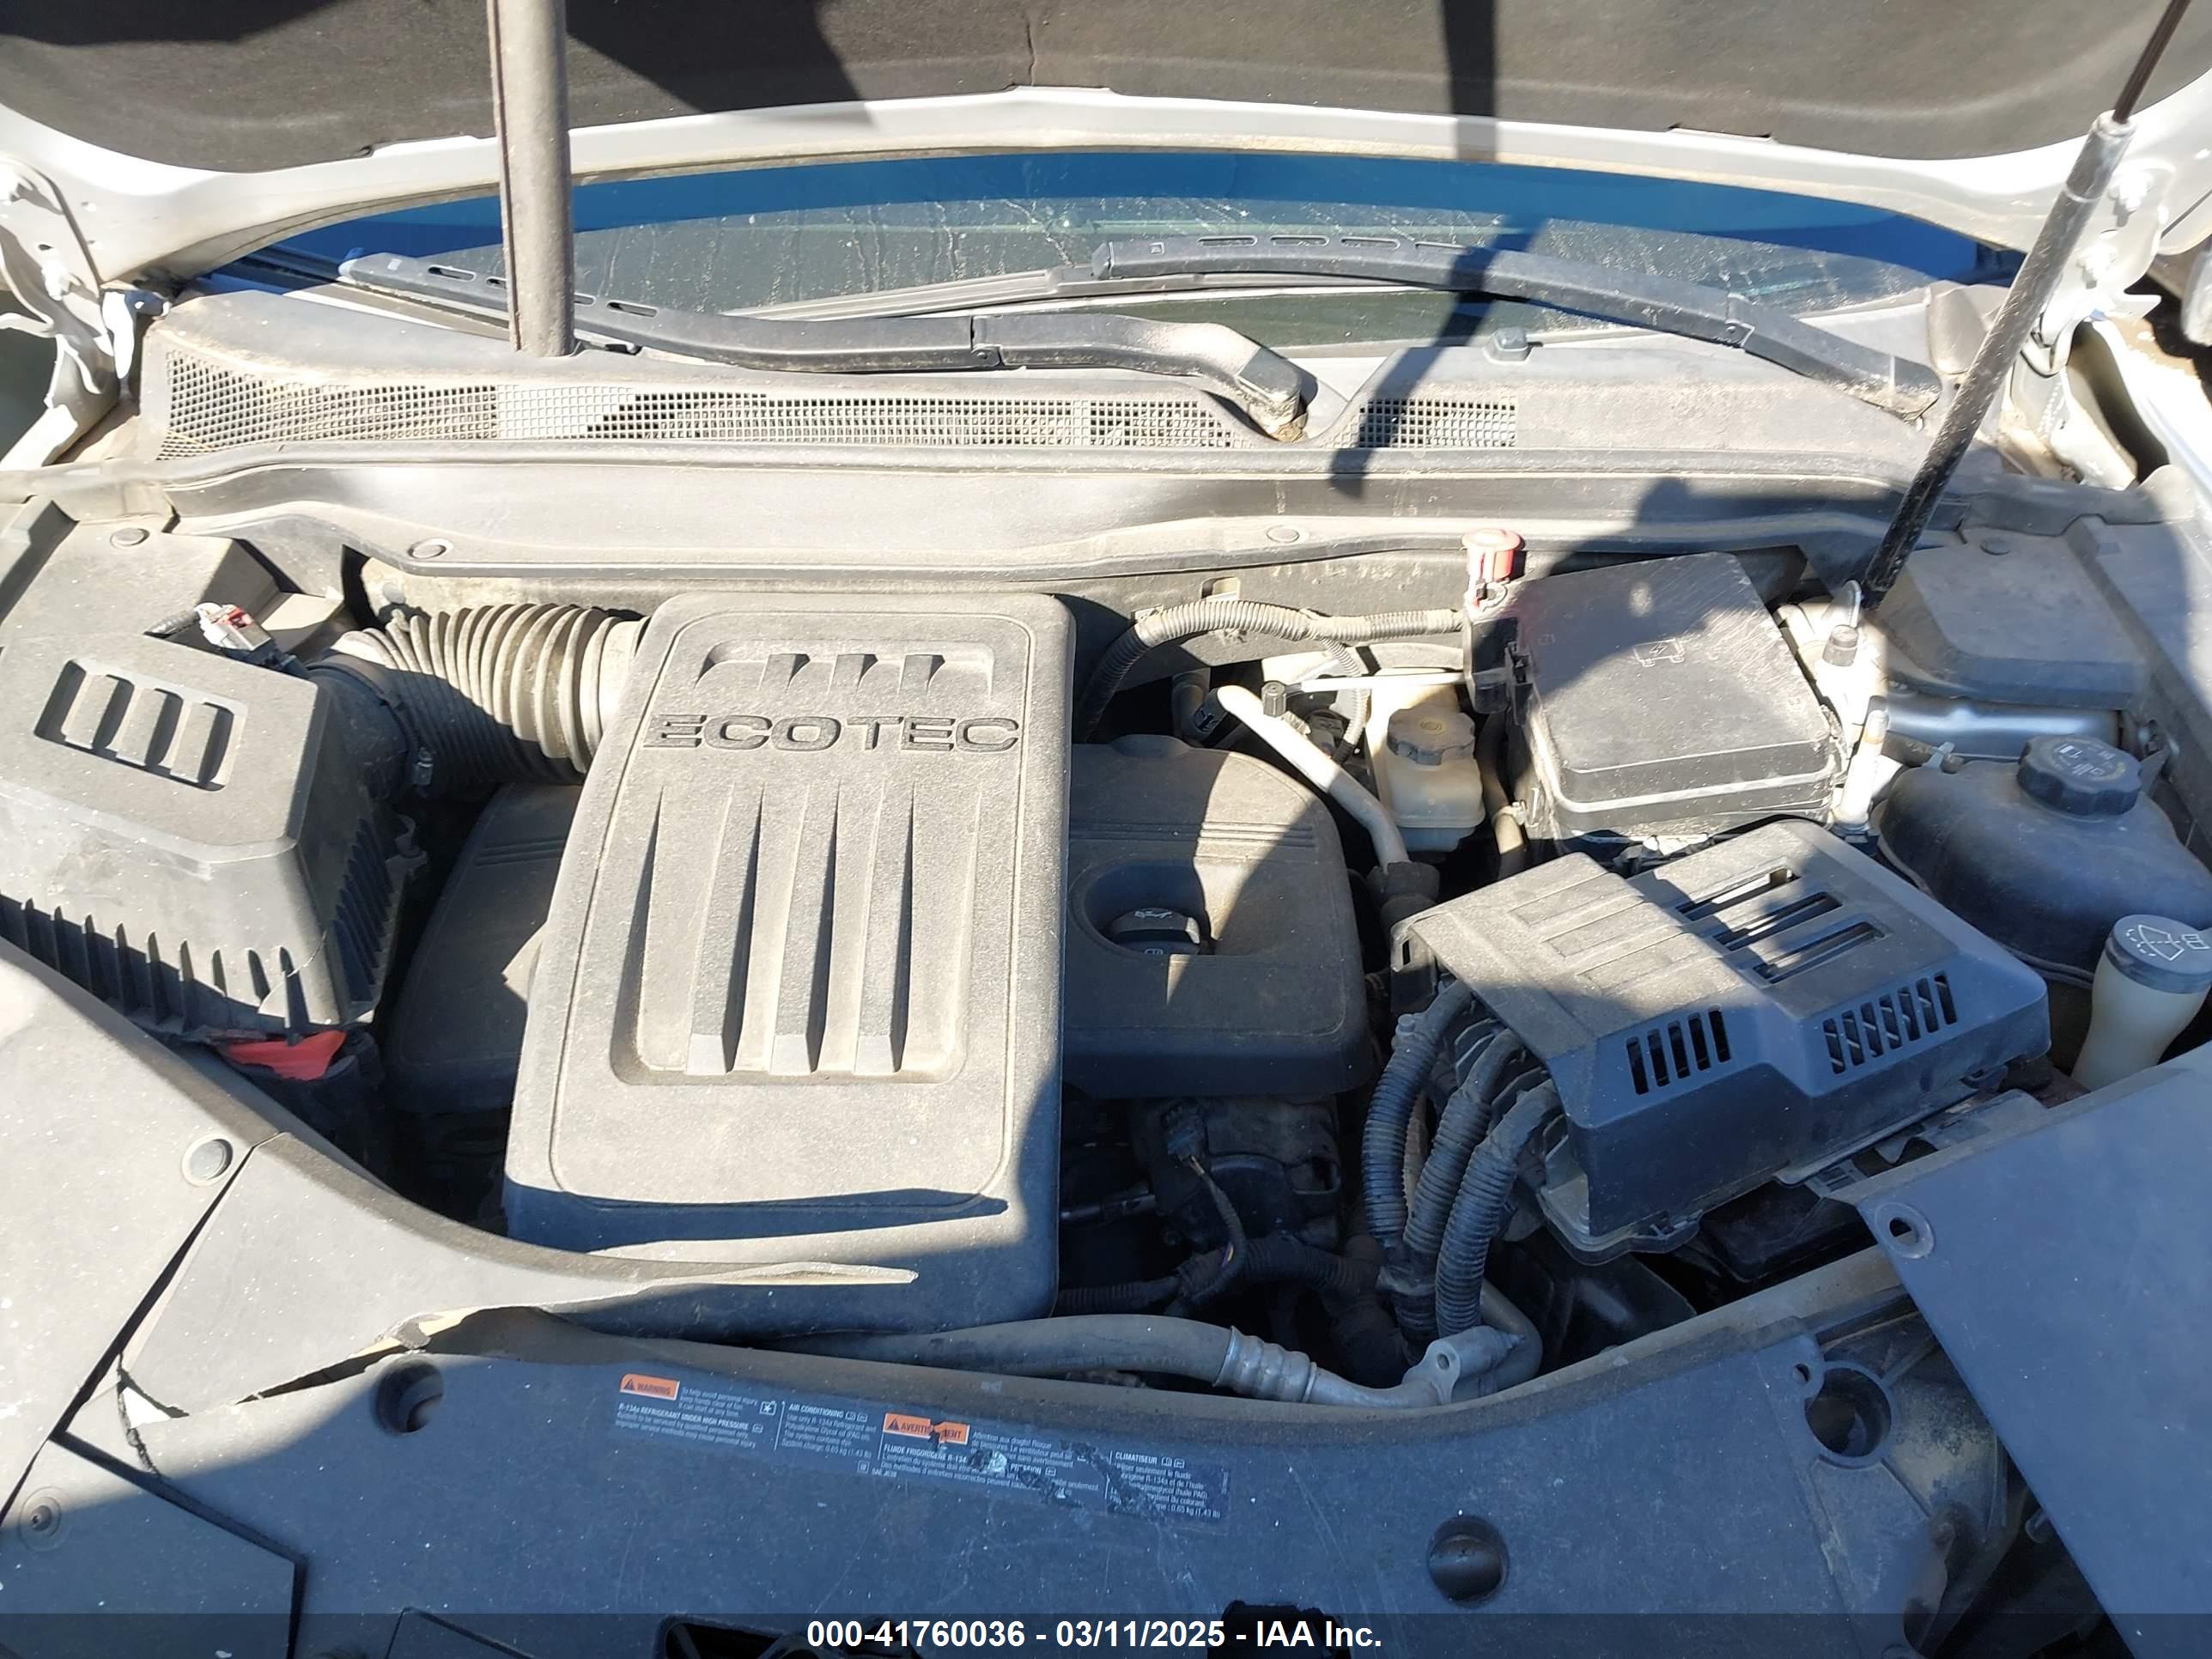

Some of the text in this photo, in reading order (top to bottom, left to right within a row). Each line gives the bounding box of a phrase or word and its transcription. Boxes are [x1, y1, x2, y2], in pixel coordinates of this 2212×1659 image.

[643, 714, 1018, 752] ECOTEC
[636, 1382, 671, 1395] WARNING
[788, 1403, 844, 1419] AIR CONDITIONING
[641, 1407, 681, 1419] REFRIGERANT
[682, 1413, 702, 1423] UNDER
[702, 1417, 717, 1425] HIGH
[718, 1419, 749, 1431] PRESSURE
[884, 1444, 906, 1455] FLUIDE
[1115, 1451, 1158, 1464] CLIMATISEUR
